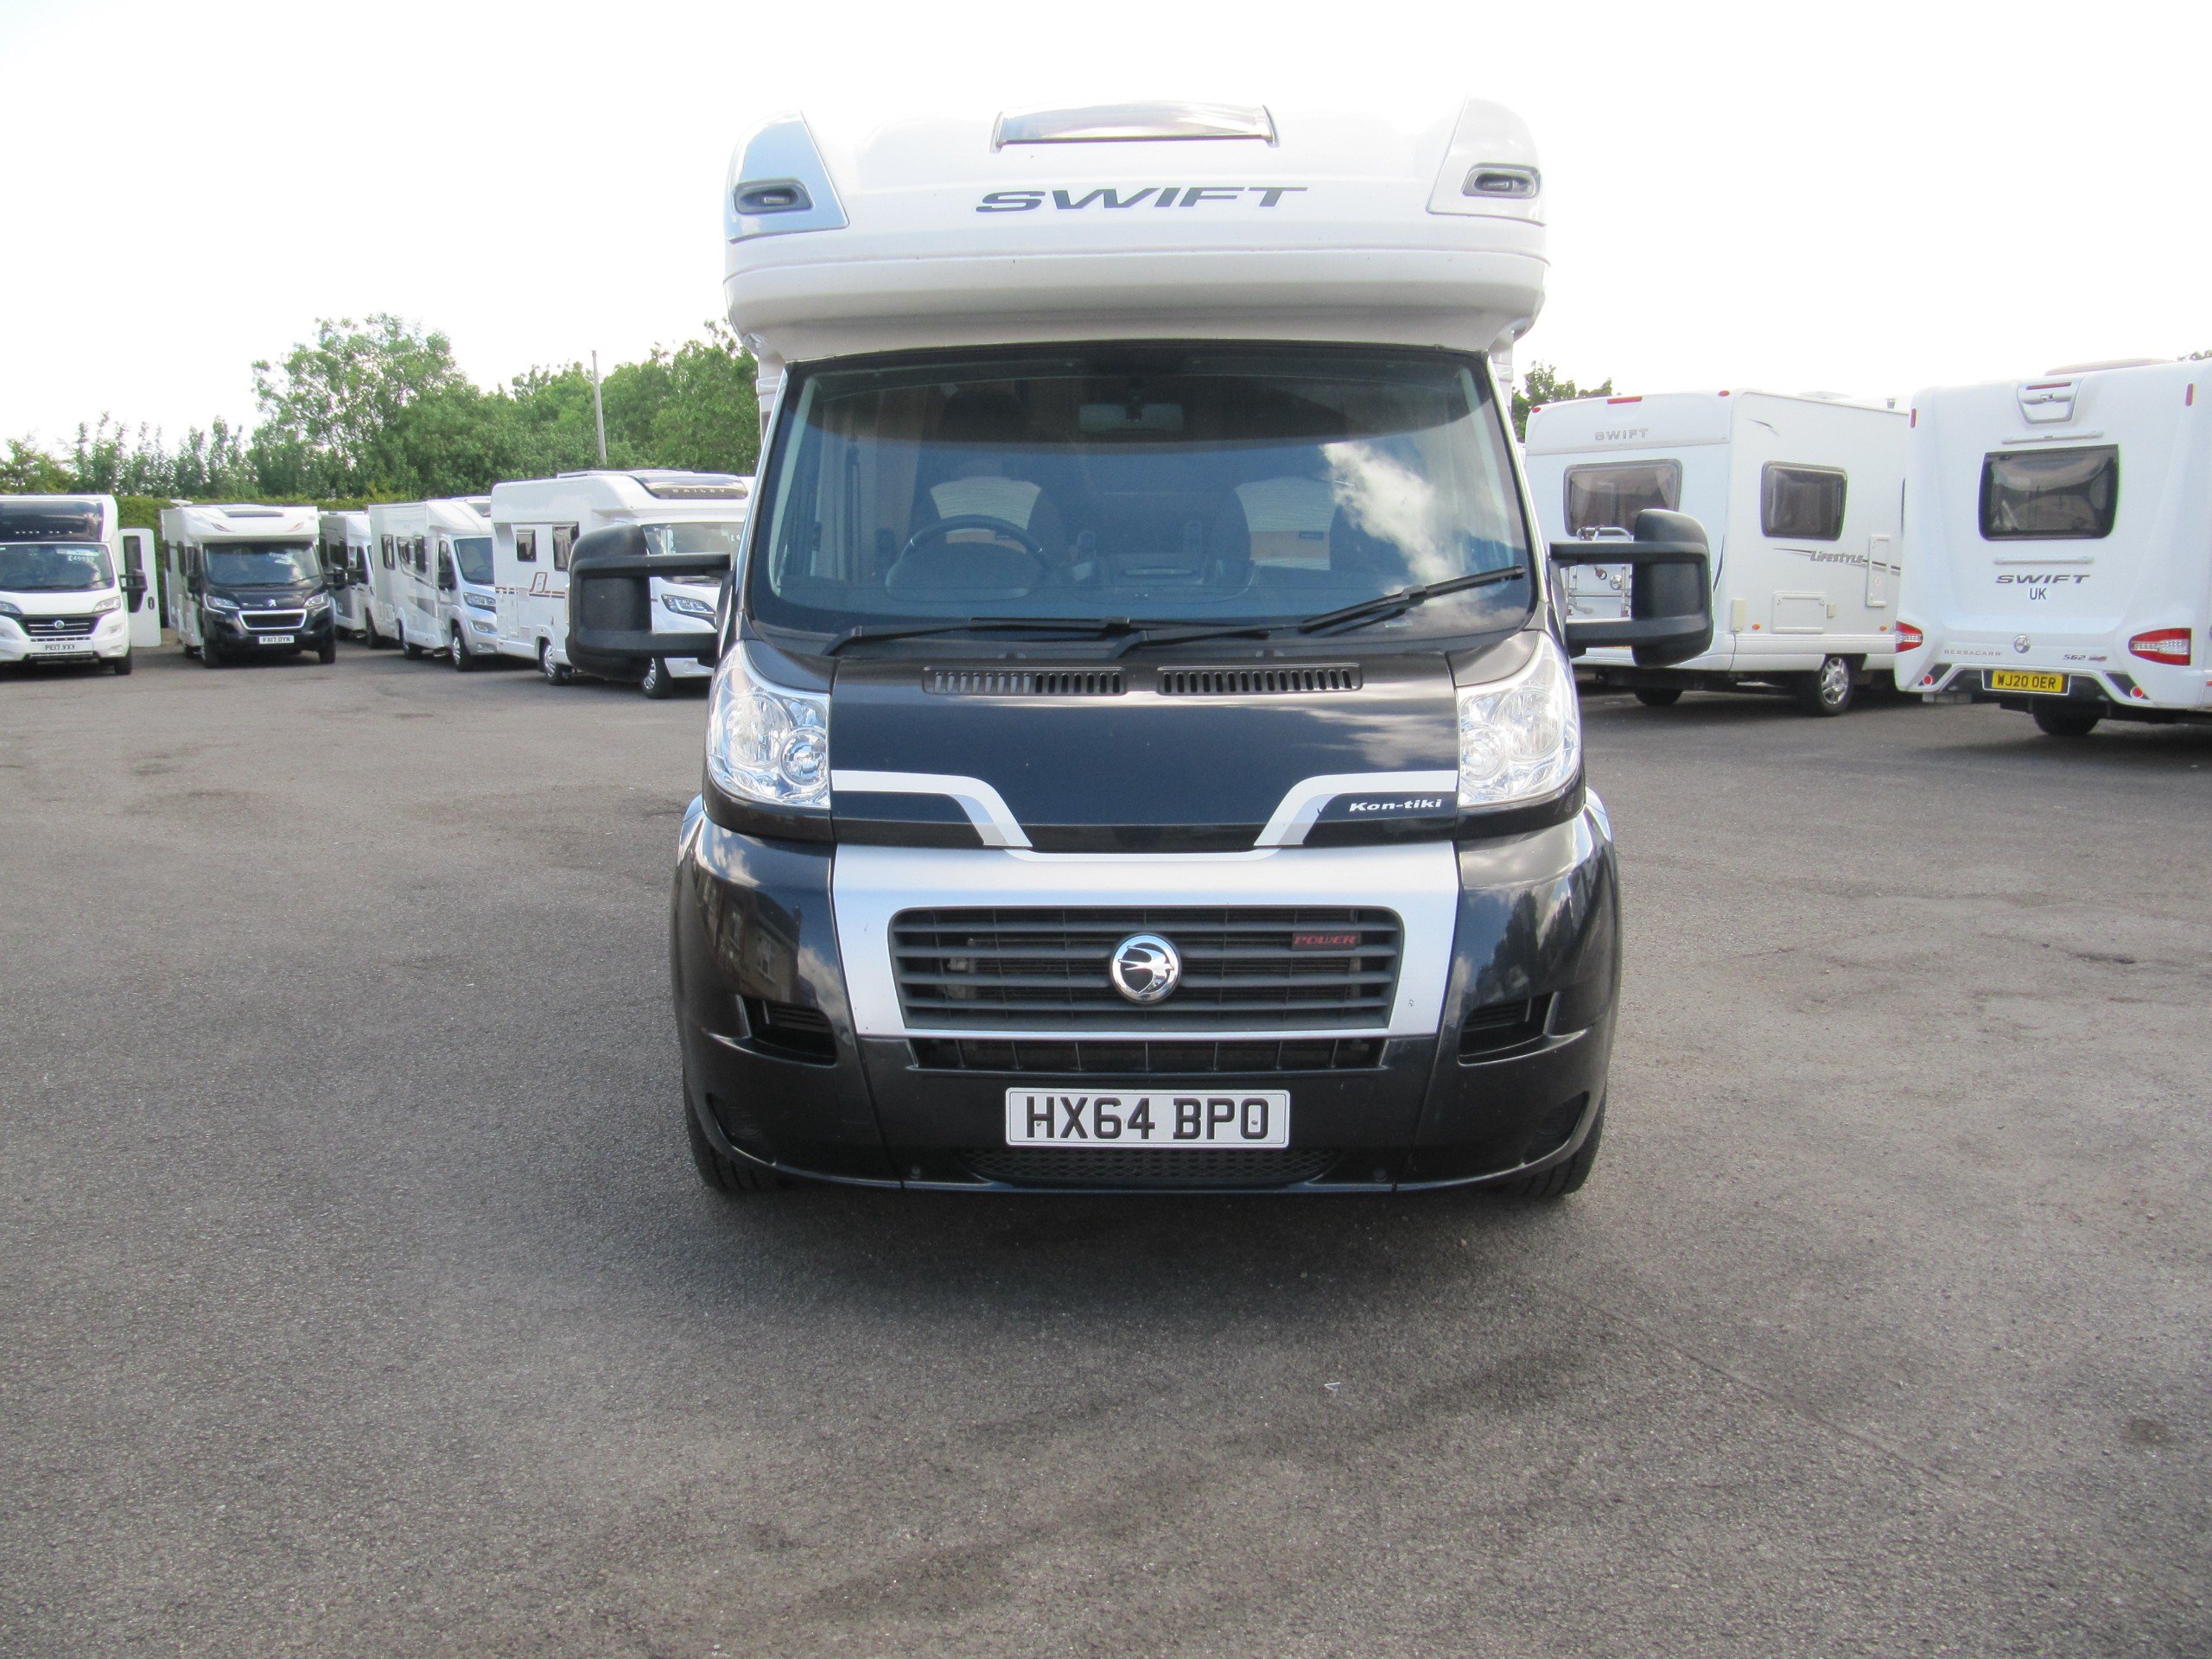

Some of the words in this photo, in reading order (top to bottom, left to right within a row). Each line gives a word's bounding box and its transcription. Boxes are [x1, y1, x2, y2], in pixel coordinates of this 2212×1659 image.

[976, 187, 1308, 213] SWIFT
[1594, 428, 1649, 441] SWIFT
[1995, 574, 2091, 584] SWIFT
[2029, 587, 2047, 600] UK
[1997, 674, 2029, 688] WJ20
[2031, 676, 2056, 690] OER
[1349, 798, 1443, 812] Kon-tiki
[1294, 935, 1356, 944] POWER
[1026, 1096, 1155, 1140] HX64
[1173, 1097, 1269, 1140] BPO
